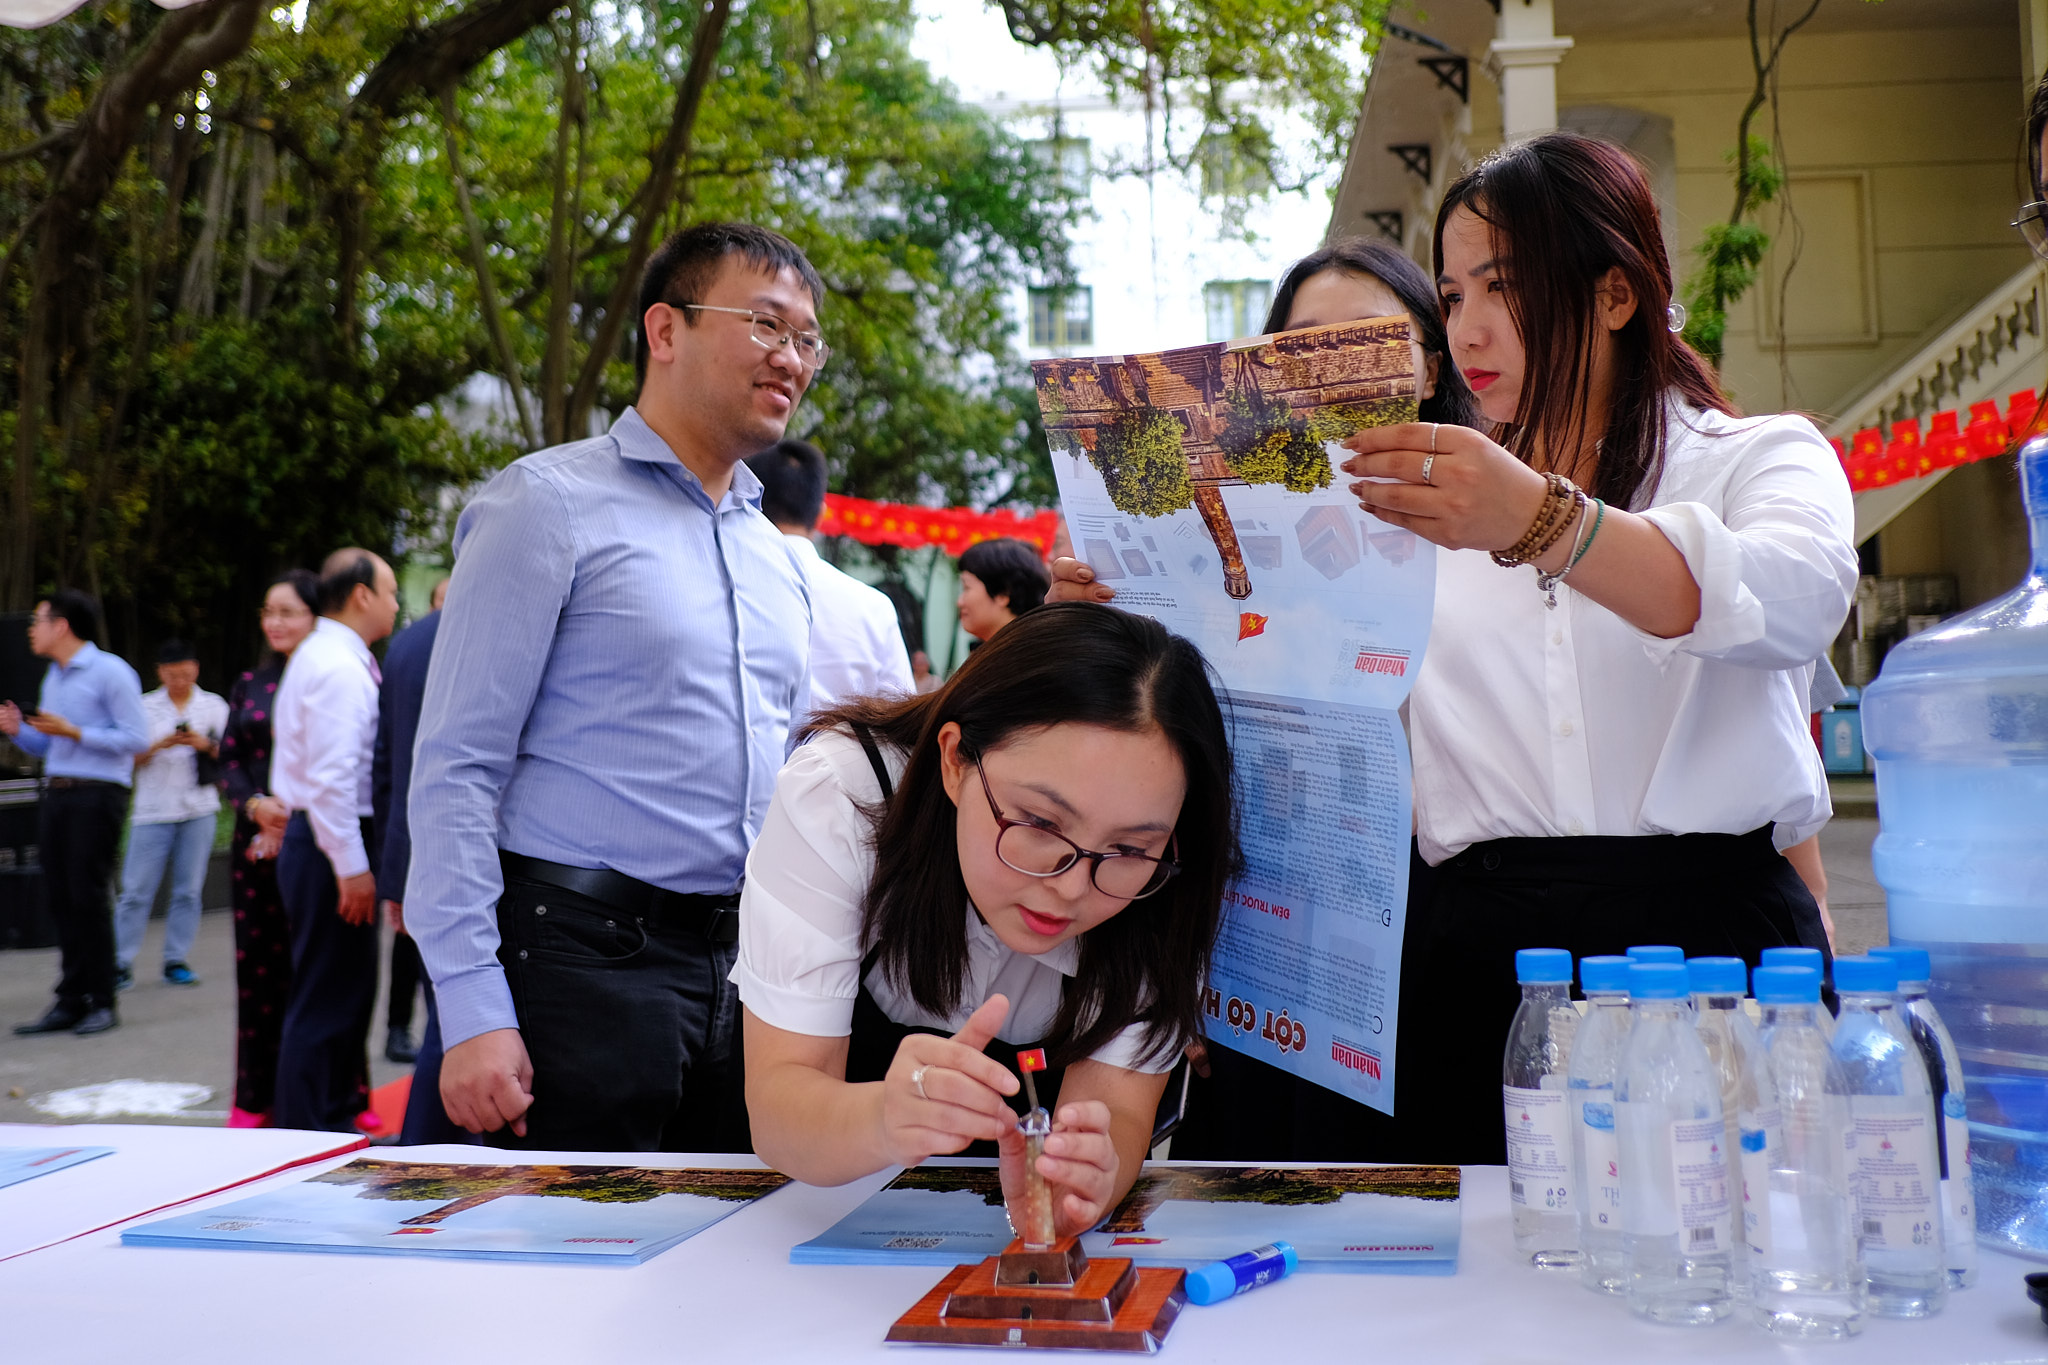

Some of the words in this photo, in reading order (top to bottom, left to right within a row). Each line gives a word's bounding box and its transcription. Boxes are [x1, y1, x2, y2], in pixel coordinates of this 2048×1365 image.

[1226, 996, 1257, 1037] CỜ
[1262, 1009, 1306, 1054] CỘT
[1332, 1046, 1352, 1068] Dân
[1353, 1059, 1381, 1080] Nhân
